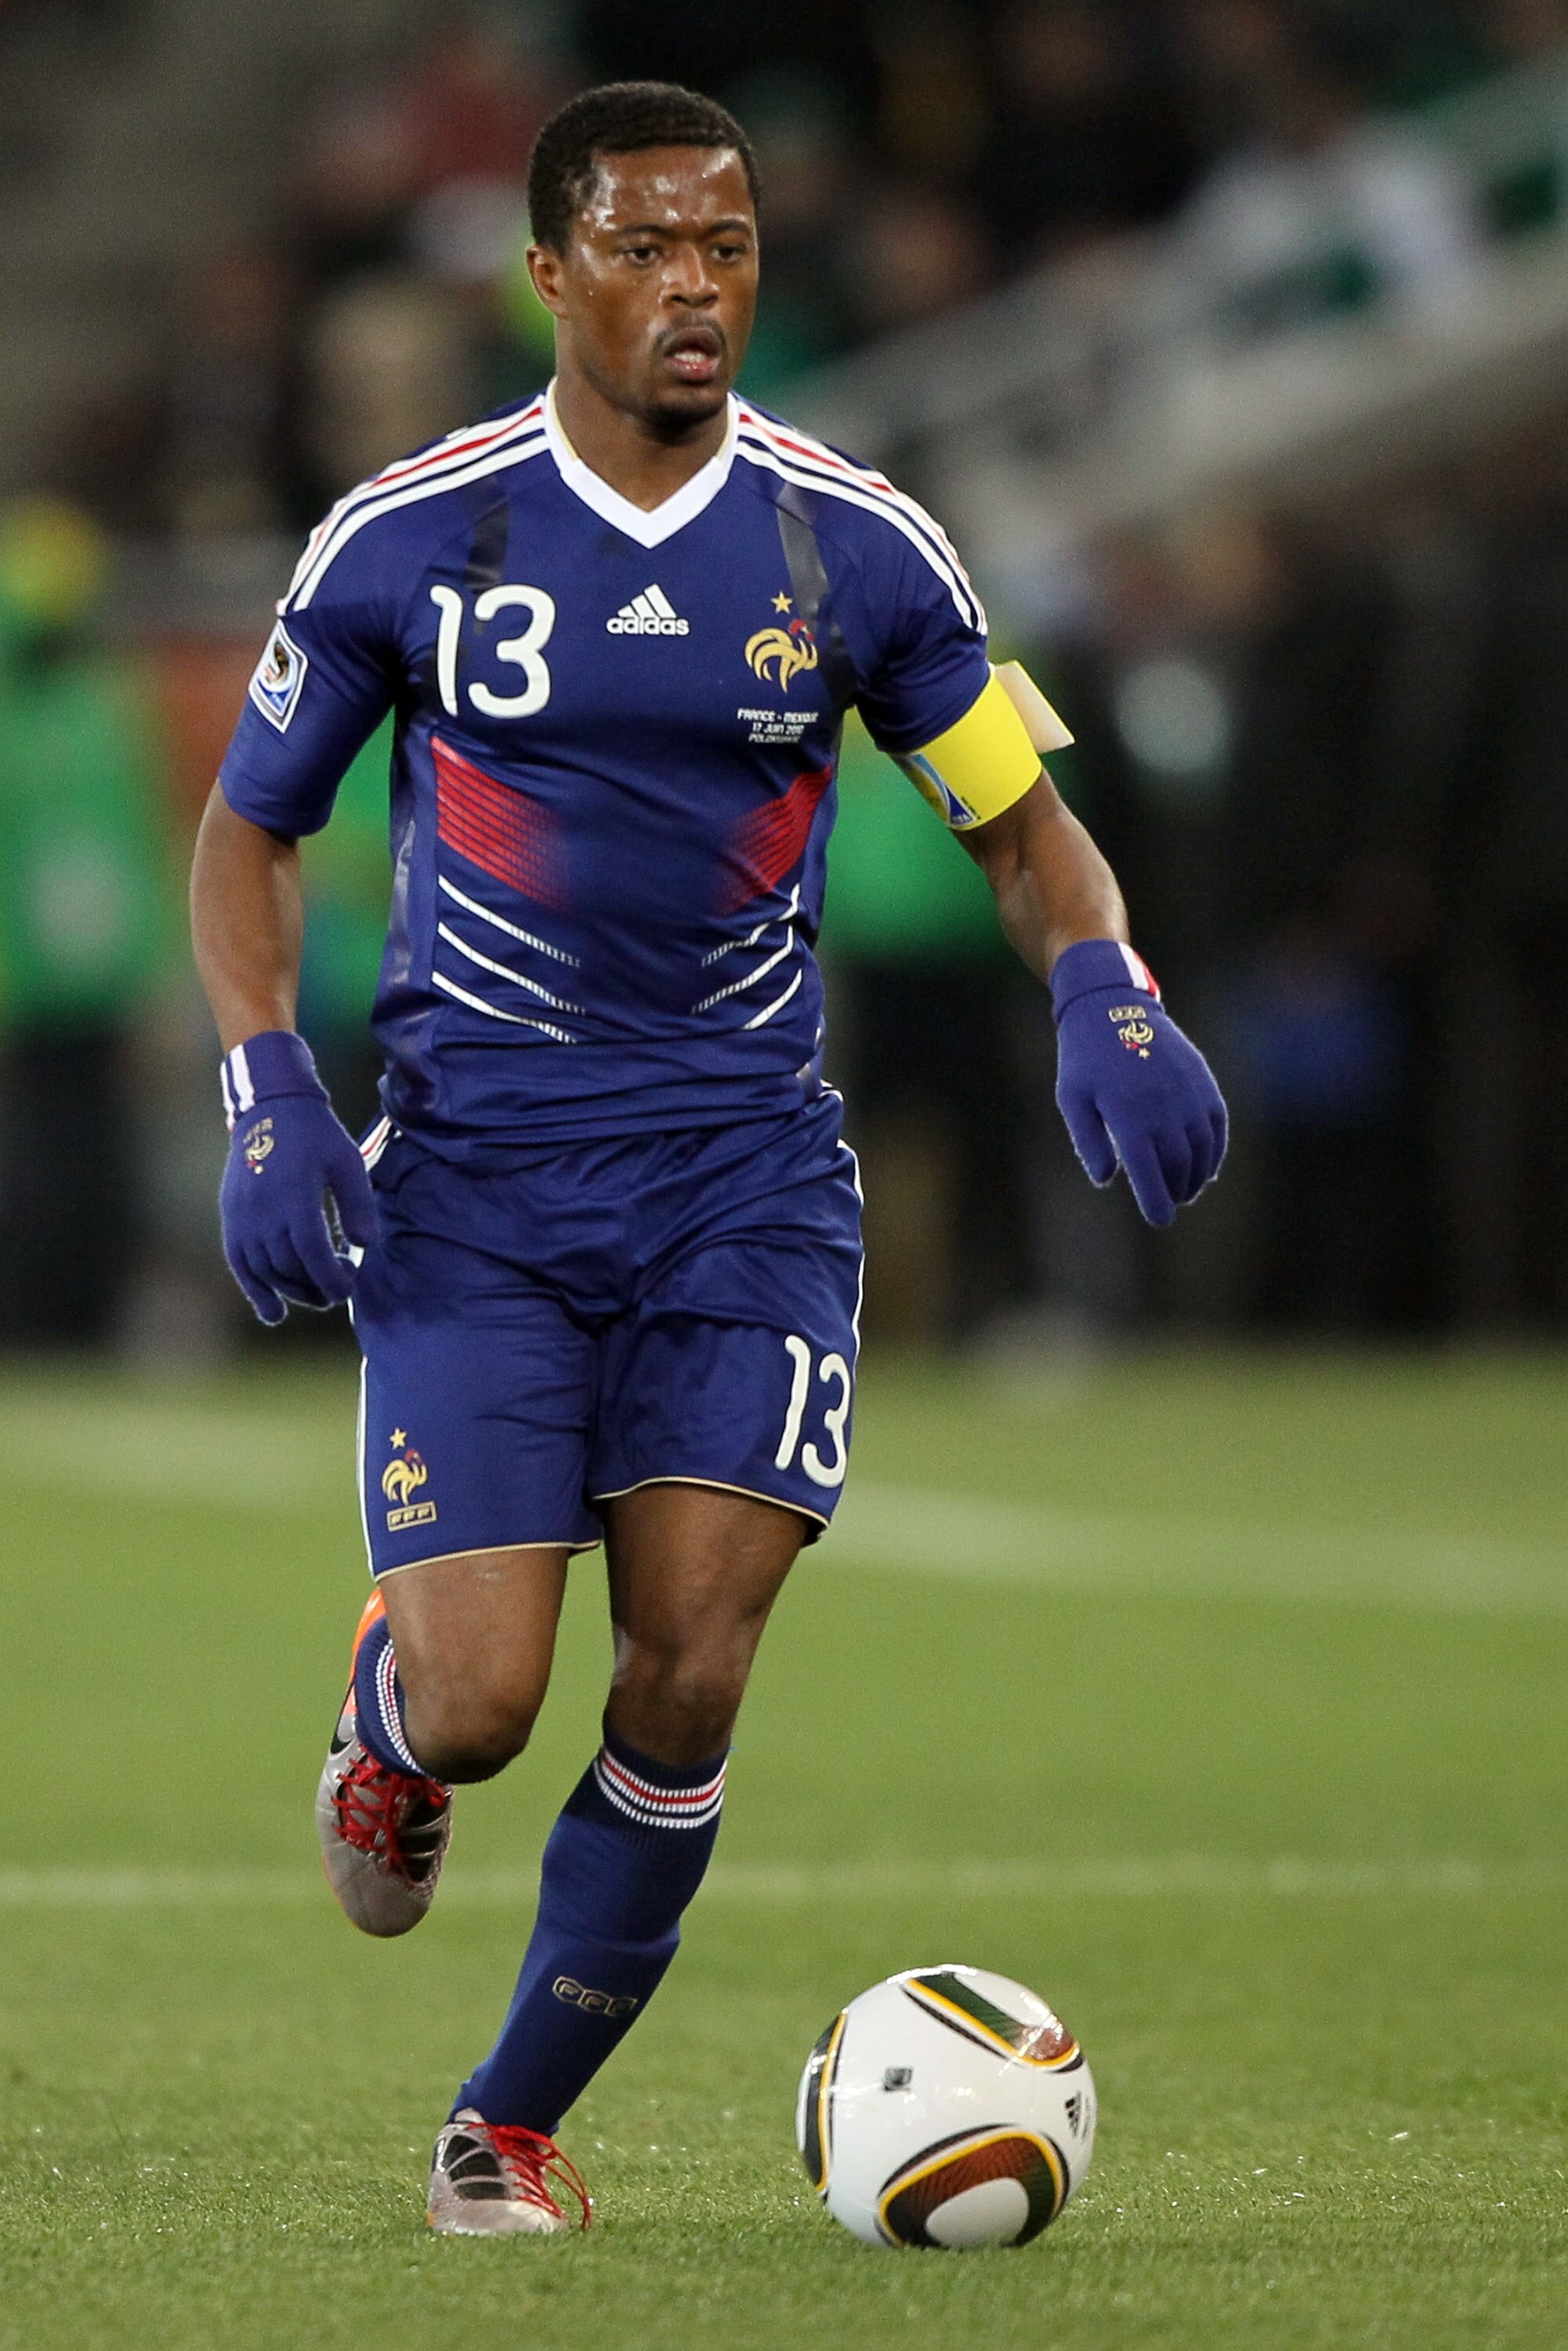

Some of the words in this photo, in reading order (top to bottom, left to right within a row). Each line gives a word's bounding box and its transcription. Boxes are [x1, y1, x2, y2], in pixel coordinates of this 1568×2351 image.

[606, 616, 690, 636] adidas
[430, 584, 556, 719] 13
[737, 708, 776, 723] FRANCE
[753, 721, 762, 733] 17
[774, 1335, 851, 1488] 13
